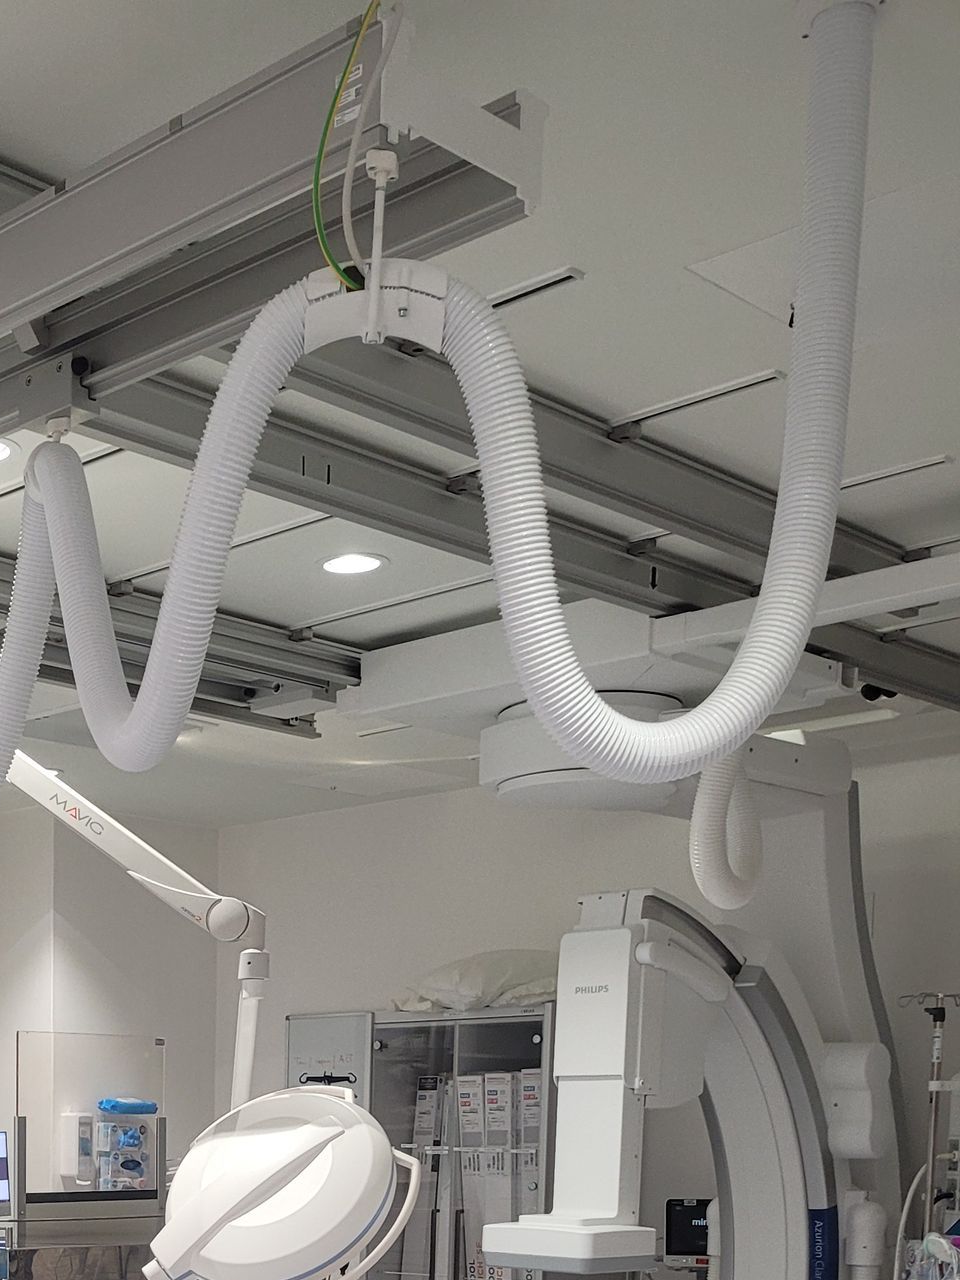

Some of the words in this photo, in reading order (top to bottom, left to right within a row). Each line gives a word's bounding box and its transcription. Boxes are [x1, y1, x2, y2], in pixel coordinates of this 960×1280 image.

[49, 793, 104, 835] MAVIG
[575, 984, 609, 994] PHILIPS
[814, 1220, 824, 1258] Azurion
